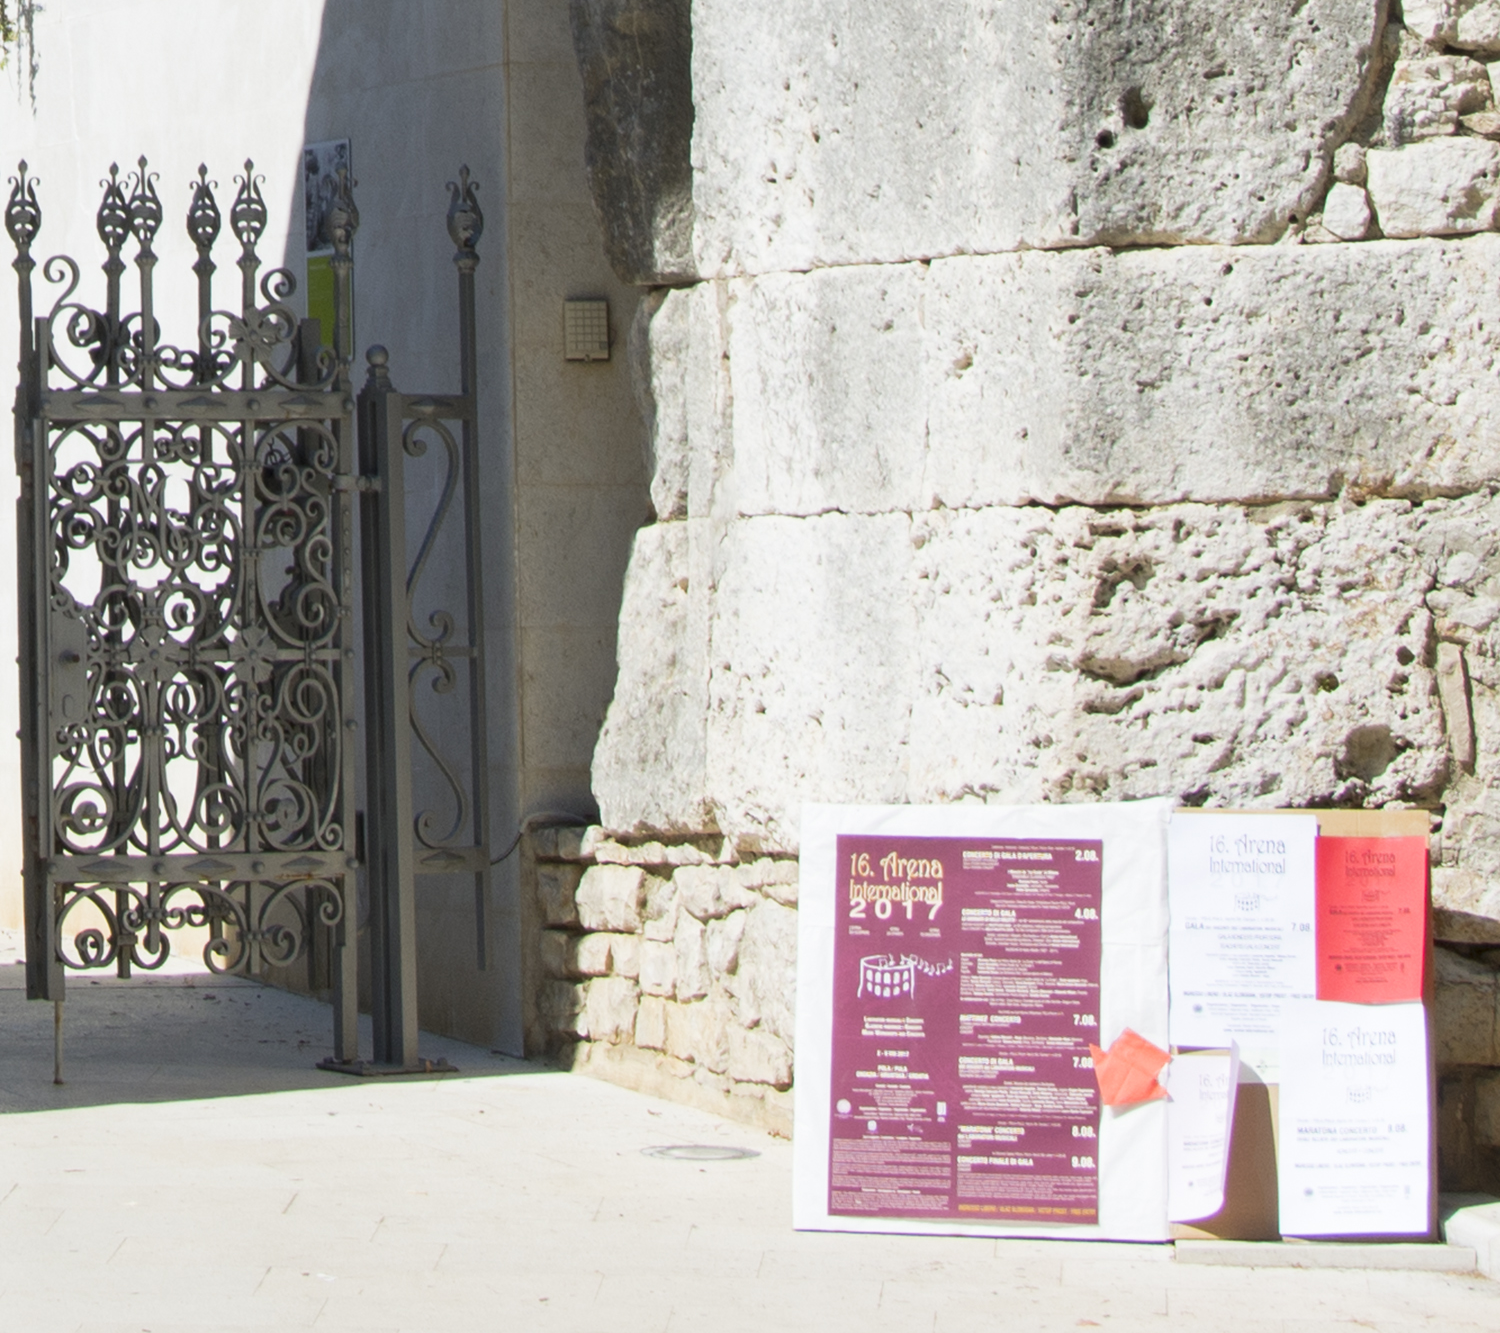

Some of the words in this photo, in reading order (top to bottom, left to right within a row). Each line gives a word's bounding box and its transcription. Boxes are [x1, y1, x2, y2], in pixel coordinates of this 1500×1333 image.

[1210, 834, 1229, 854] 16.
[1234, 833, 1286, 856] Arena
[1075, 849, 1100, 862] 2.08.
[850, 852, 875, 877] 16.
[880, 851, 944, 881] Arena
[1209, 856, 1286, 874] International
[848, 878, 943, 902] International
[848, 898, 943, 921] 2017
[1074, 908, 1099, 920] 4.08.
[1073, 1014, 1098, 1026] 7.08.
[1322, 1027, 1342, 1046] 16.
[1347, 1026, 1397, 1049] Arena
[1322, 1049, 1396, 1066] International
[1071, 1125, 1096, 1138] 8.08.
[1297, 1126, 1337, 1134] MARATONA
[1339, 1126, 1377, 1134] CONCERTO
[1071, 1156, 1096, 1168] 9.08.
